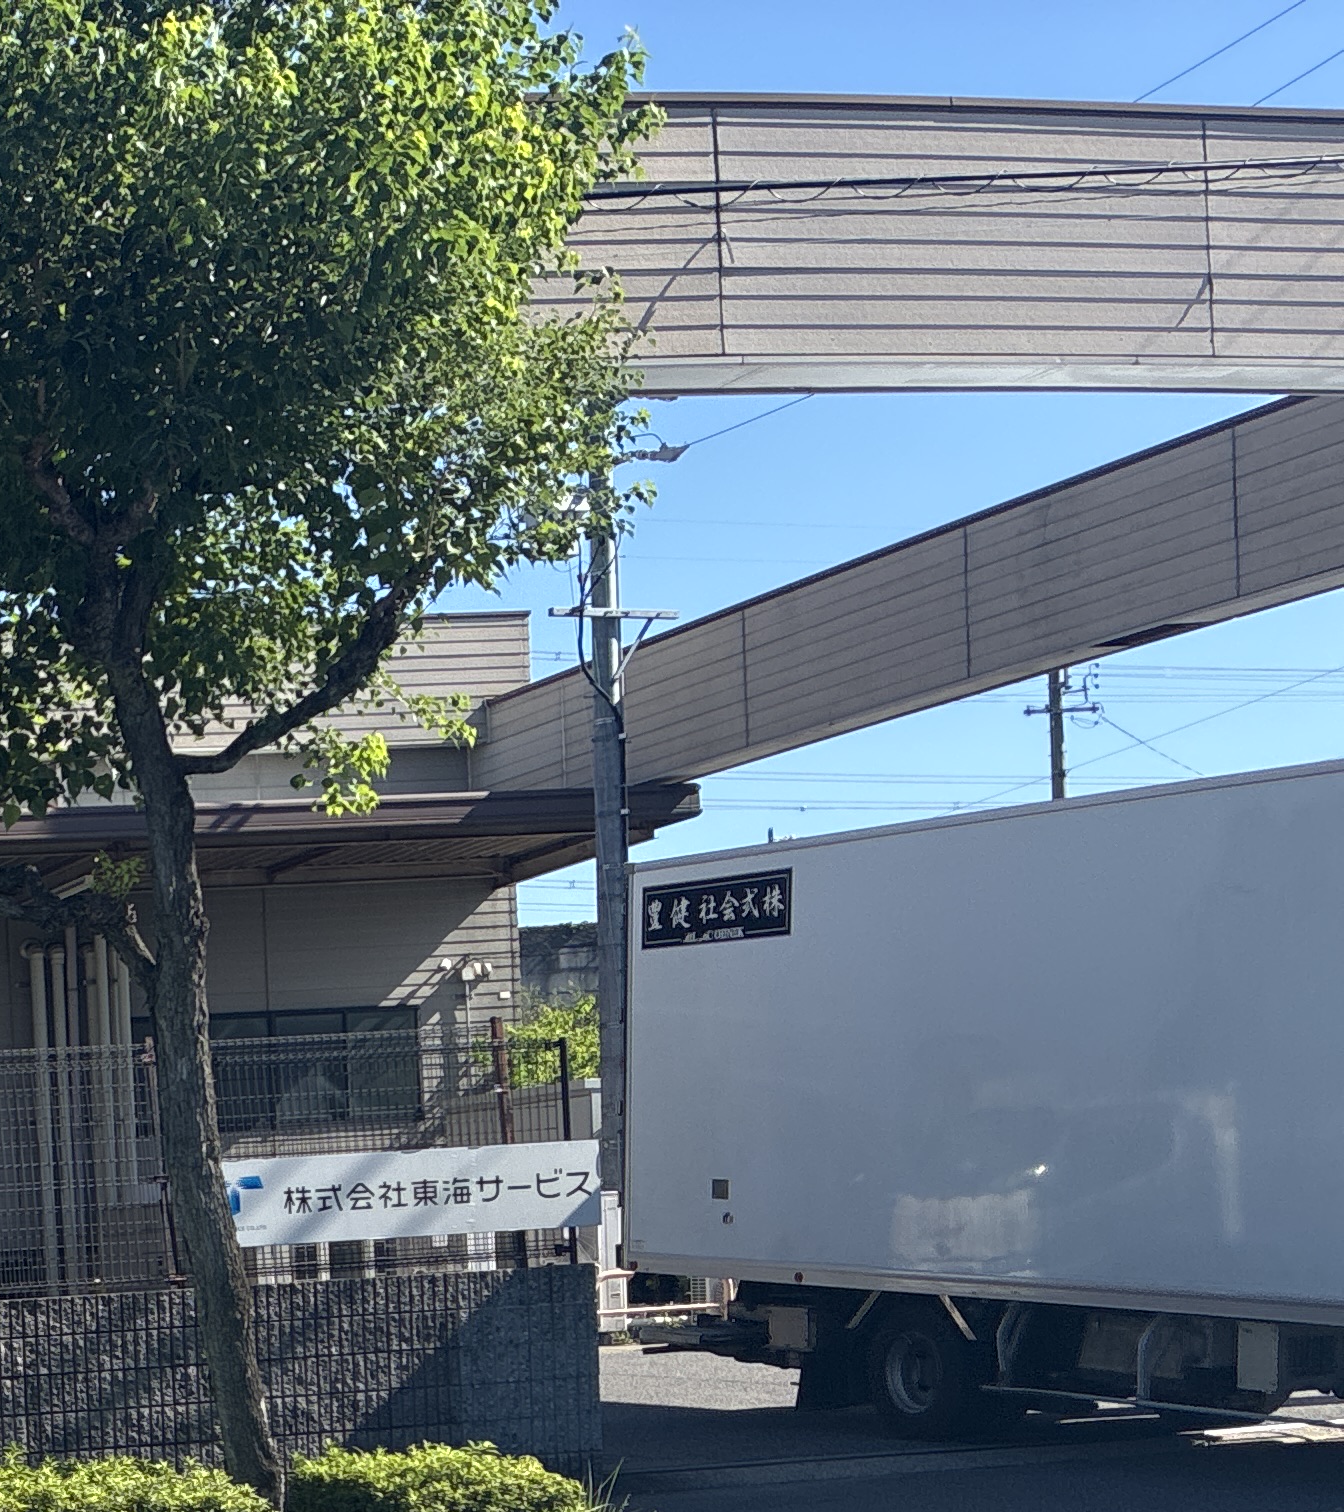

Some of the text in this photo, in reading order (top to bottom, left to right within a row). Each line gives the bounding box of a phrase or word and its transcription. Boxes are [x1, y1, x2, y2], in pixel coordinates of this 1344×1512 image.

[283, 1168, 593, 1214] 株式会社東海サービス
